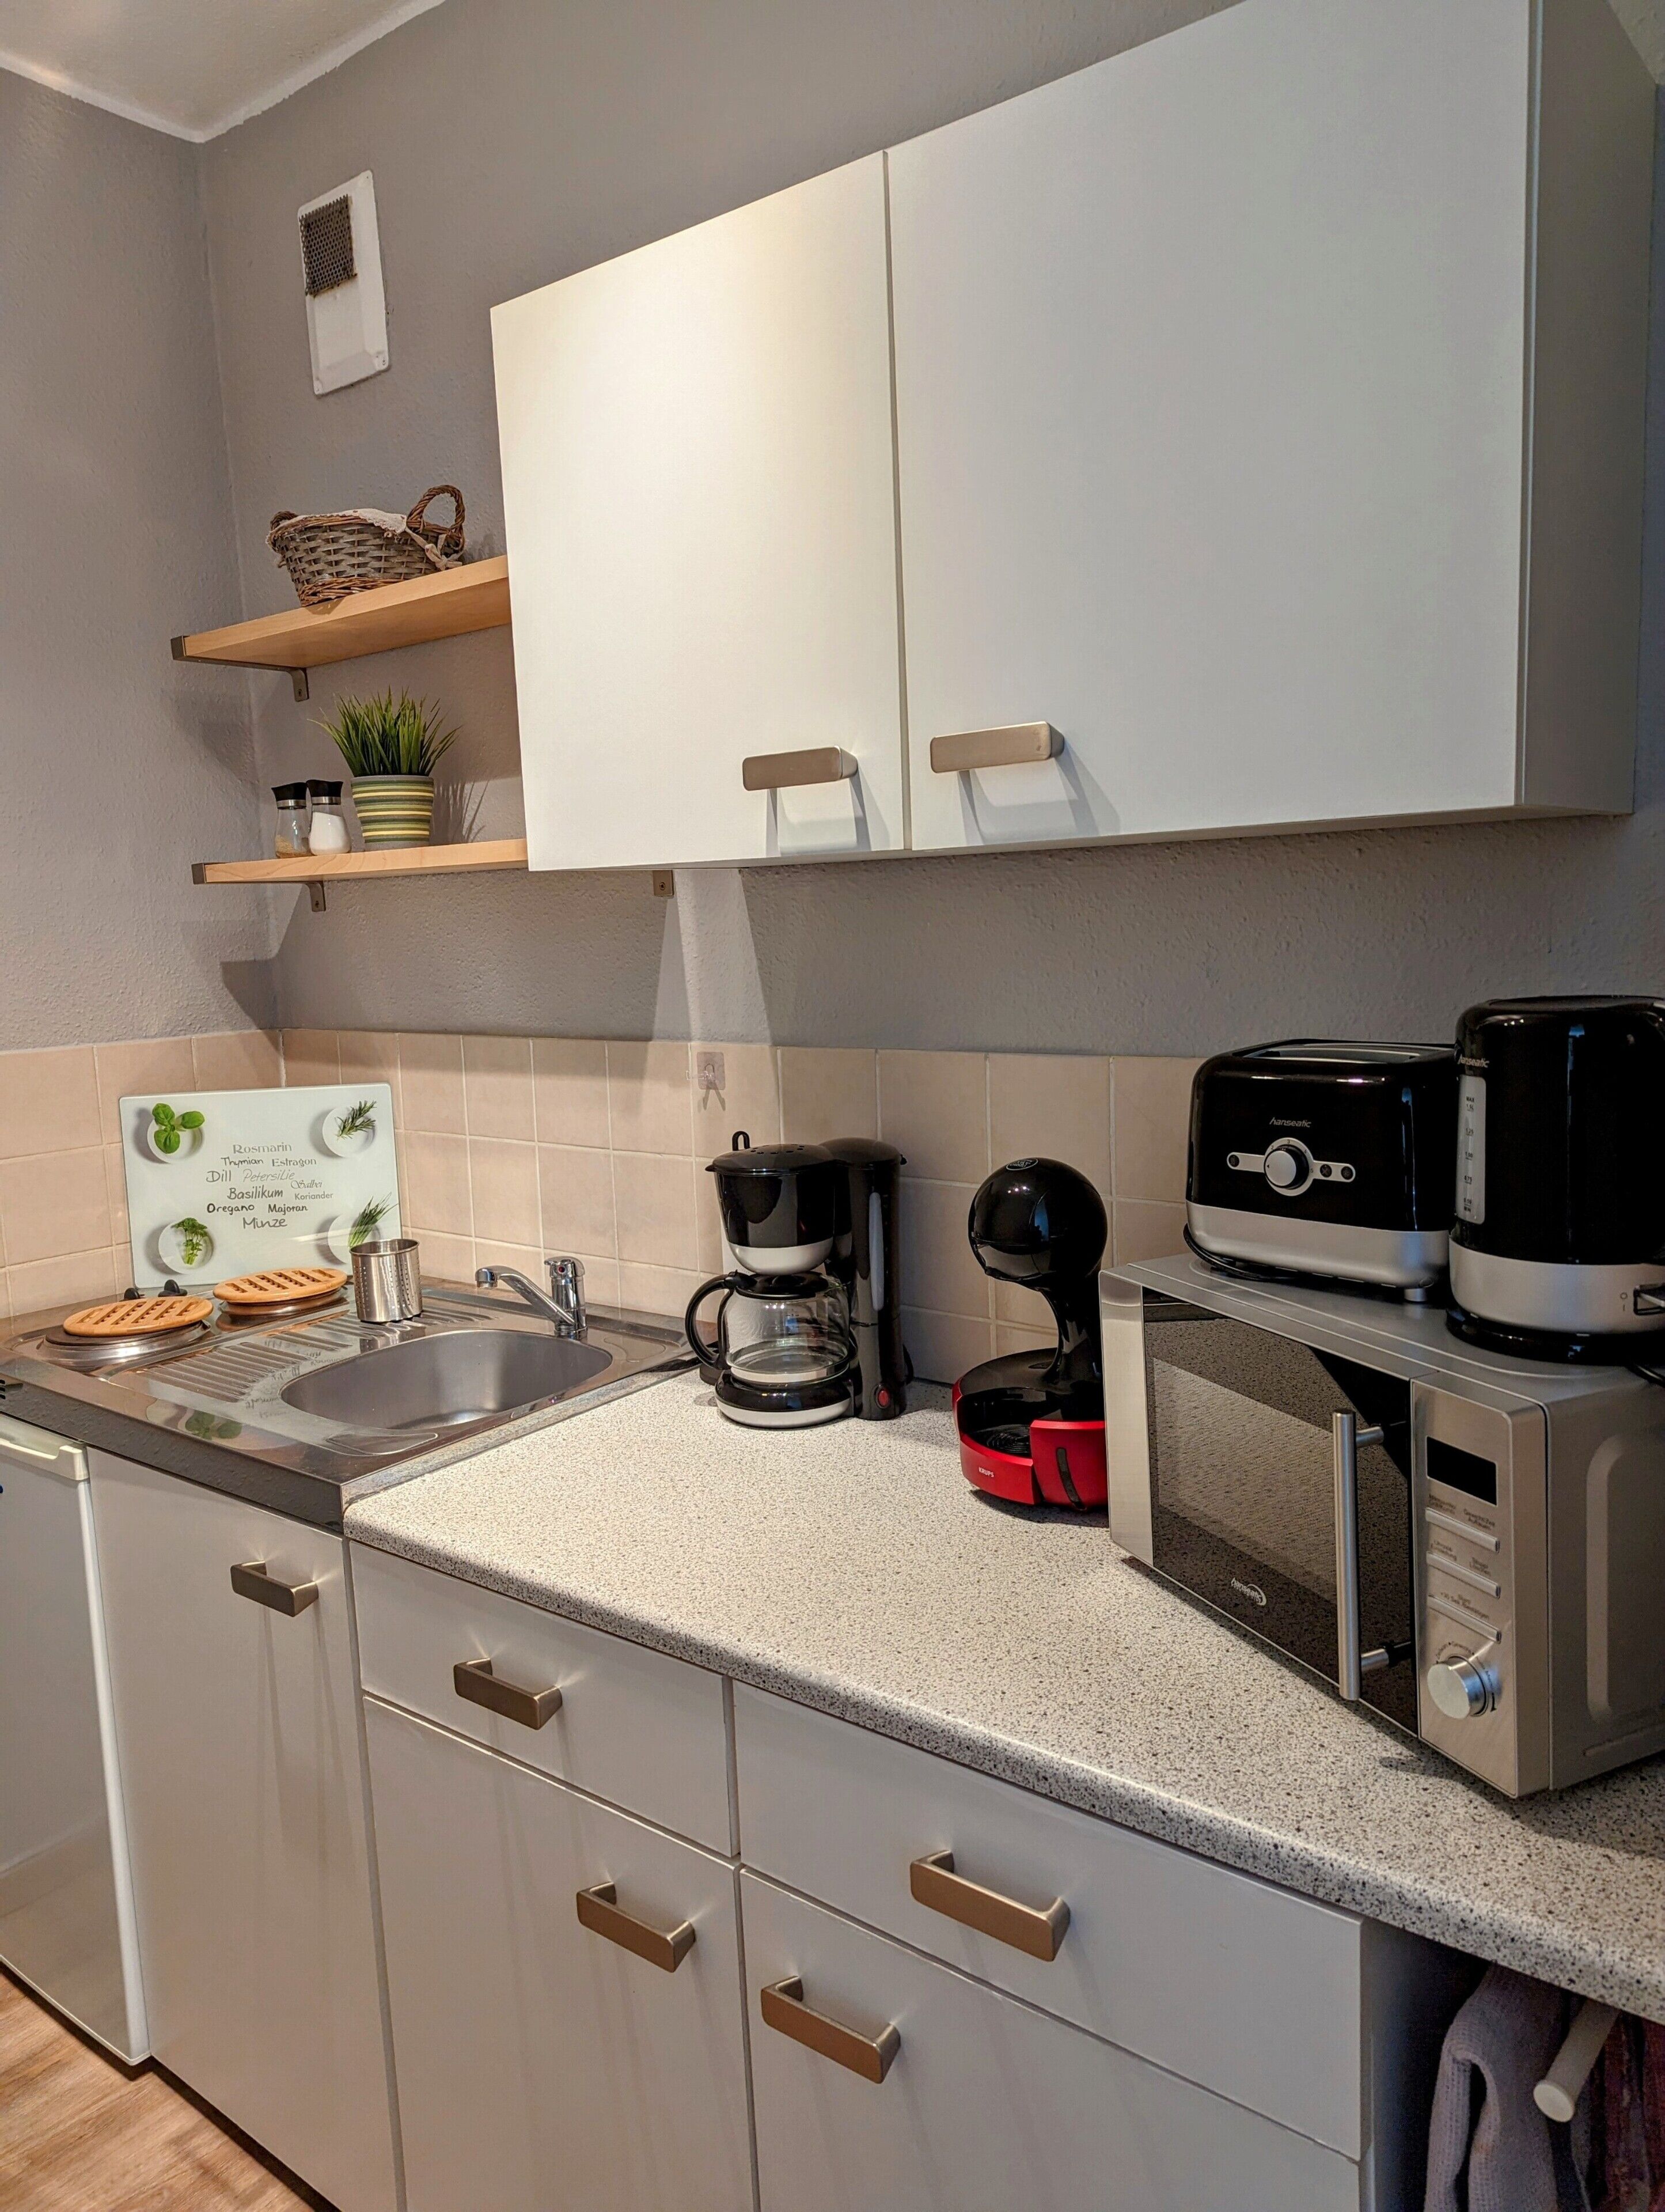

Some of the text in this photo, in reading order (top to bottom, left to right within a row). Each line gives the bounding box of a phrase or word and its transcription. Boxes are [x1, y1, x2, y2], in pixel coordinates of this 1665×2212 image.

[1269, 1117, 1311, 1127] hanseatic
[233, 1142, 292, 1154] Rosmarin
[221, 1156, 317, 1168] Thymian Estragon
[206, 1169, 232, 1183] Dill
[290, 1179, 323, 1190] Salbei
[227, 1184, 333, 1200] Basilikum Koriander
[207, 1203, 309, 1215] Oregano Majoran
[242, 1217, 287, 1229] Minze
[978, 1467, 994, 1478] KRUPS
